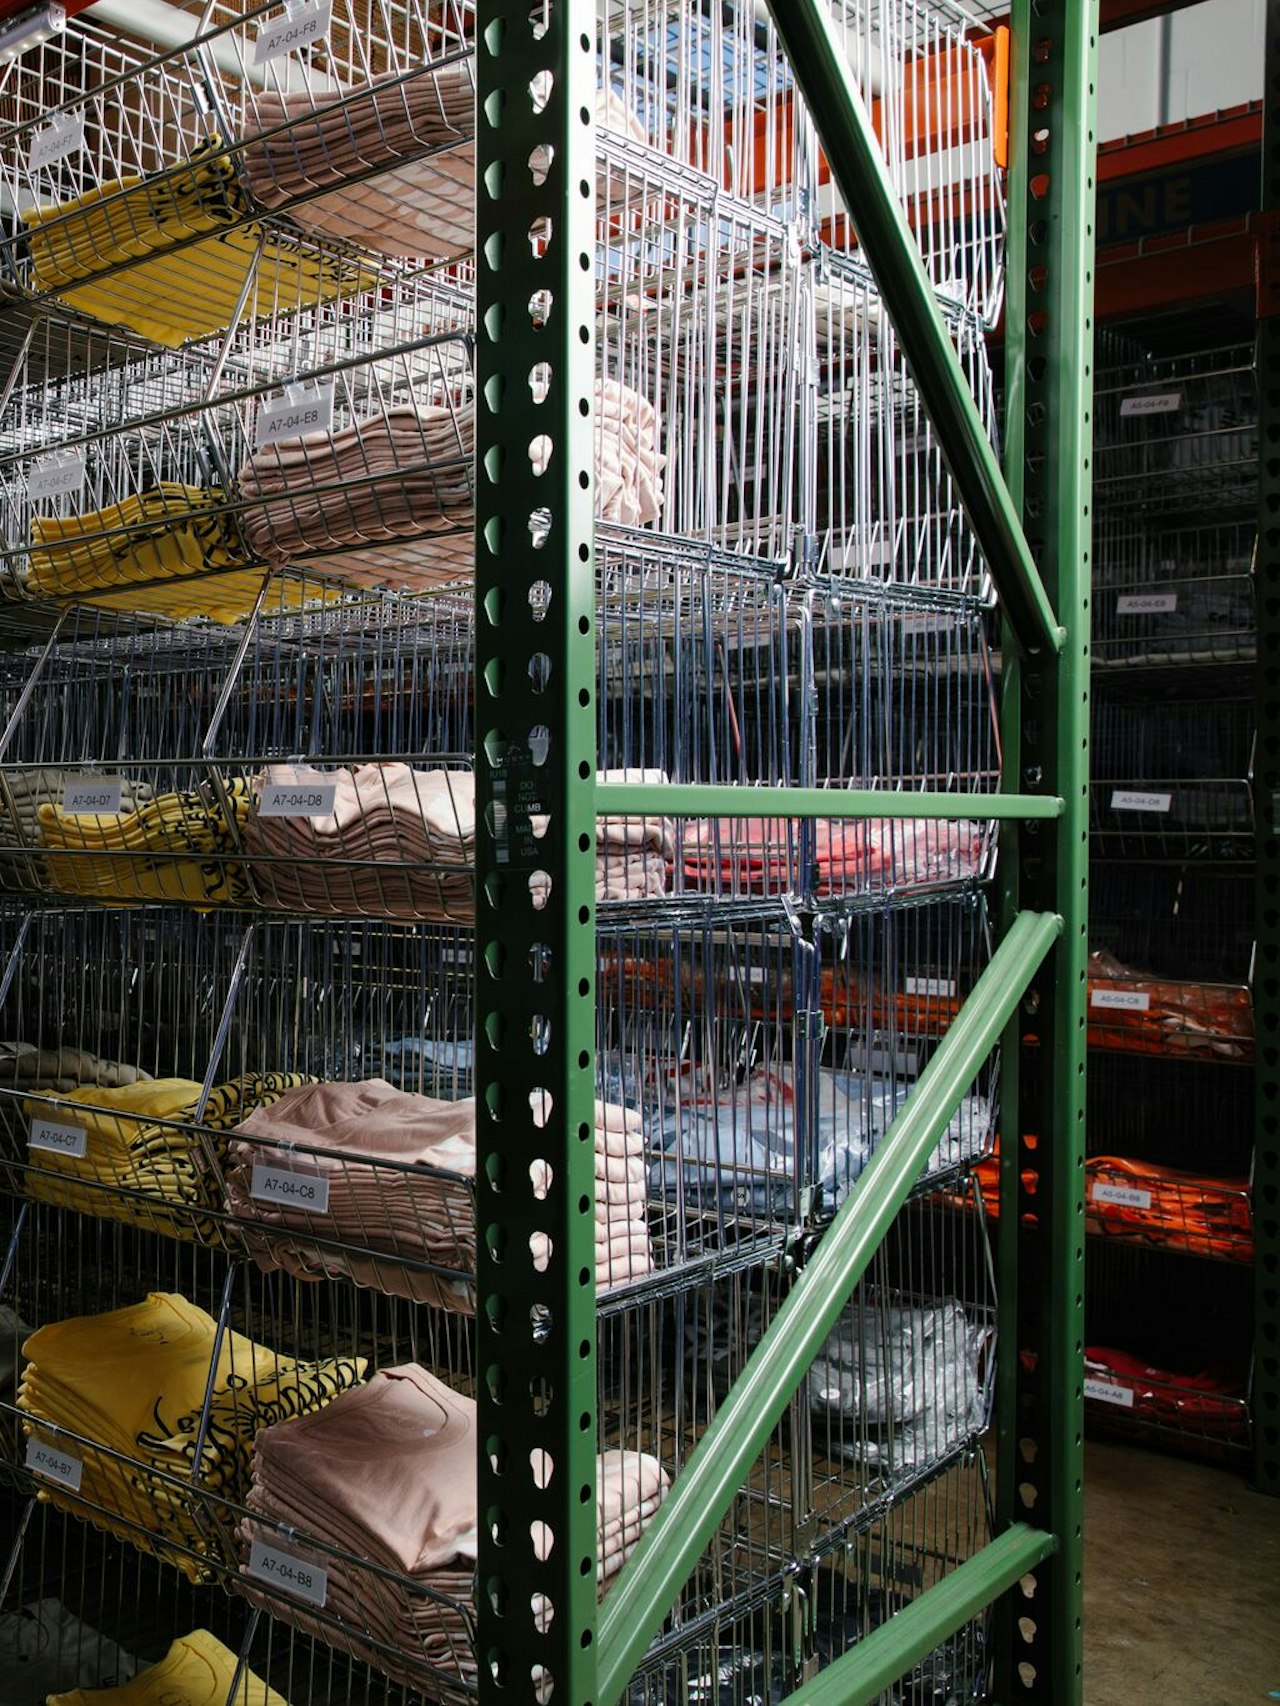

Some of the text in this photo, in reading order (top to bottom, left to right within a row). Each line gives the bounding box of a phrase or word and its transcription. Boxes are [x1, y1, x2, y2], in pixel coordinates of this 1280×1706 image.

[267, 20, 317, 50] A7-04-F8
[269, 410, 319, 432] A7-04-E8
[71, 795, 111, 806] A7-04-D7
[272, 794, 322, 806] A7-04-D8
[39, 1130, 78, 1147] A7-04-C7
[264, 1178, 315, 1199] A7-04-C8
[35, 1450, 72, 1476] A7-04-B7
[261, 1557, 312, 1588] A7-04-B8
